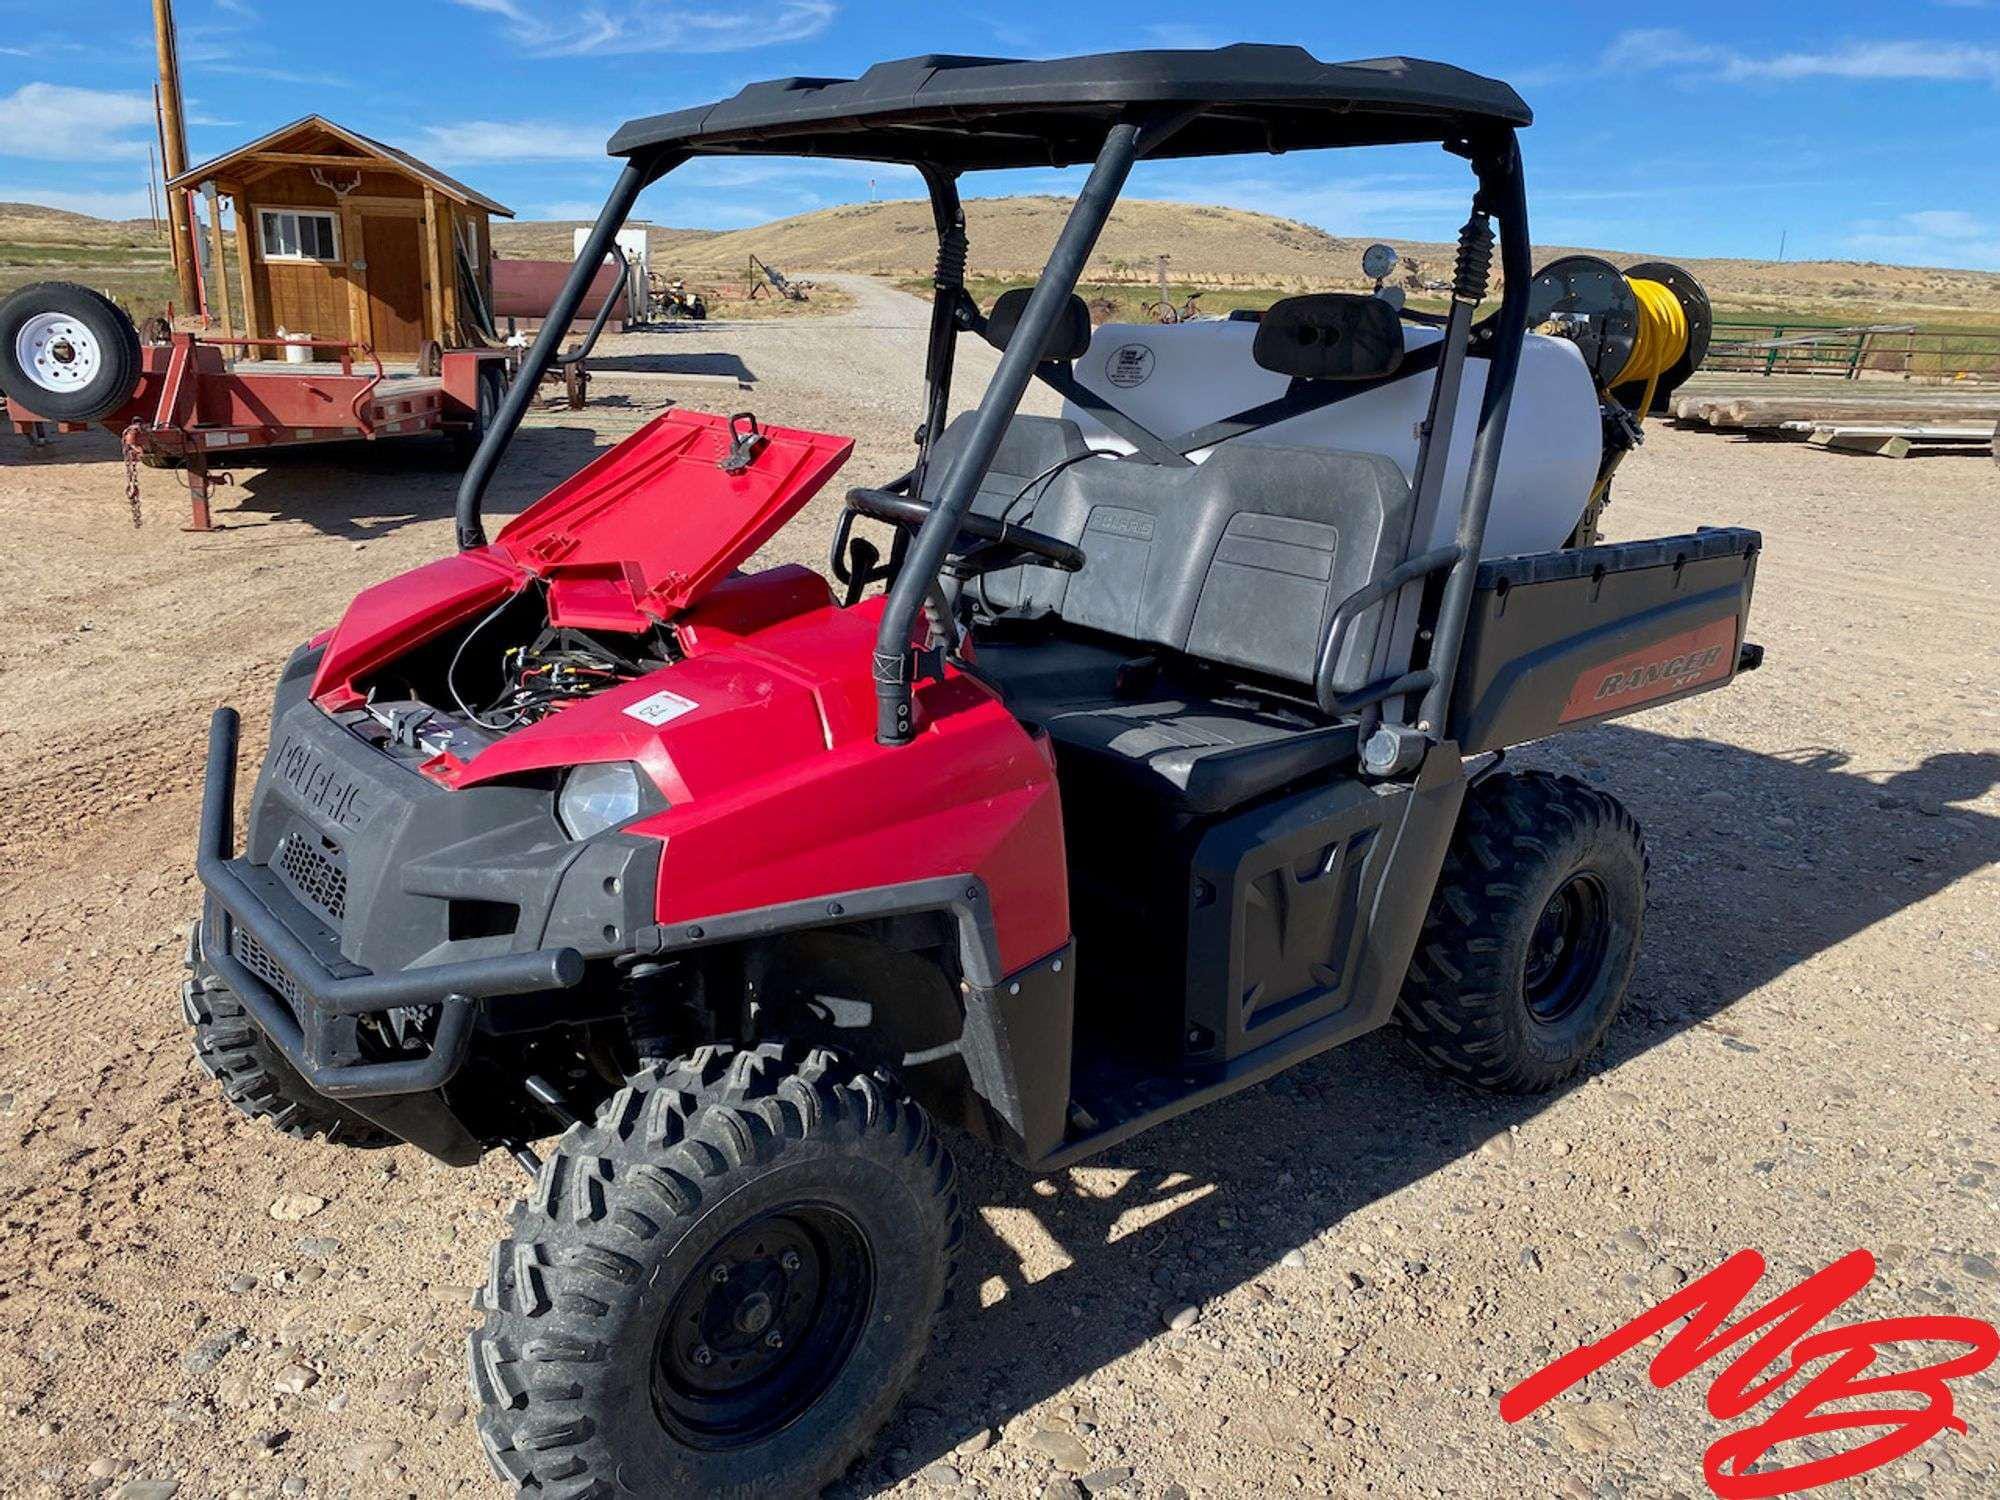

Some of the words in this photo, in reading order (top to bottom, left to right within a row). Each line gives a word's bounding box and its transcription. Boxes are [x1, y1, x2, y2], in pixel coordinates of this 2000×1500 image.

[1089, 511, 1153, 539] POLARIS
[1594, 643, 1723, 700] RANGER
[273, 735, 370, 834] POLARIS
